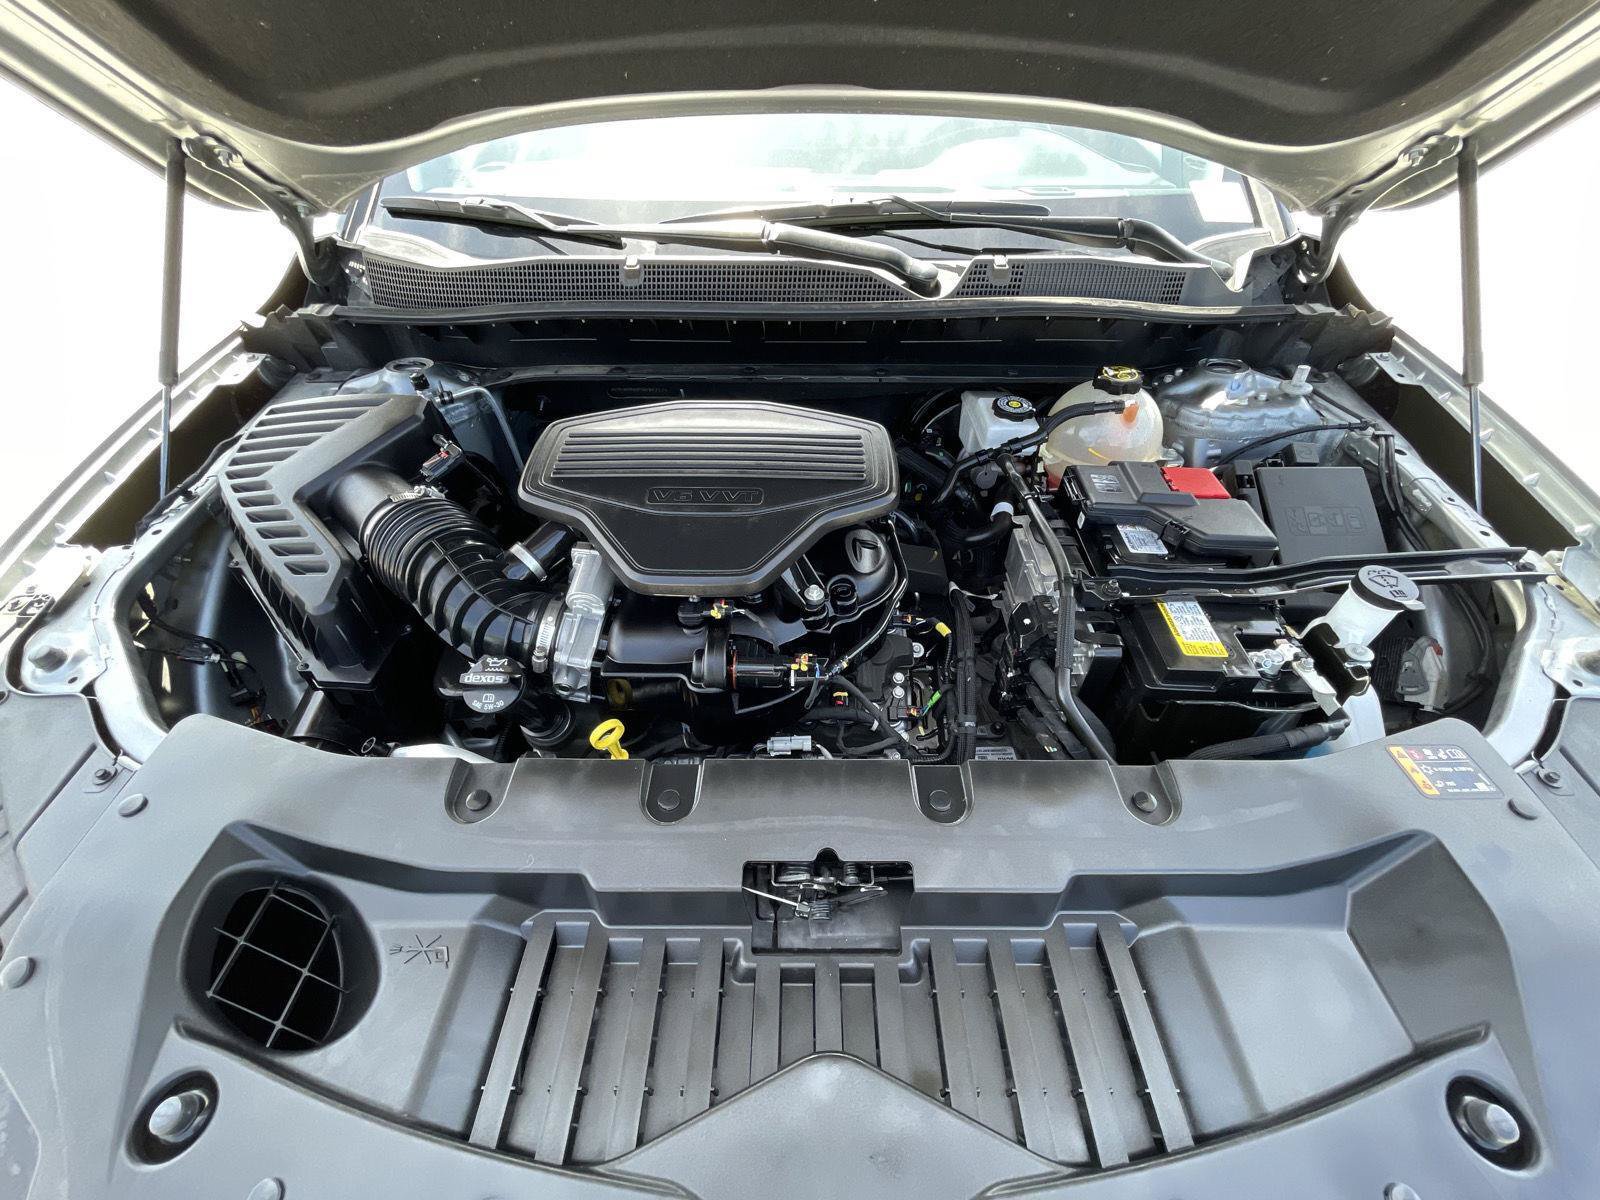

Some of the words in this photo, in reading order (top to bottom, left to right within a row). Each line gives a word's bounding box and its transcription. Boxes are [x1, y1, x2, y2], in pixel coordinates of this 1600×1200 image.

[652, 489, 693, 502] V6
[699, 489, 759, 502] VVT
[463, 673, 505, 684] dexos
[471, 699, 483, 710] SAE
[483, 699, 505, 711] 5W-30
